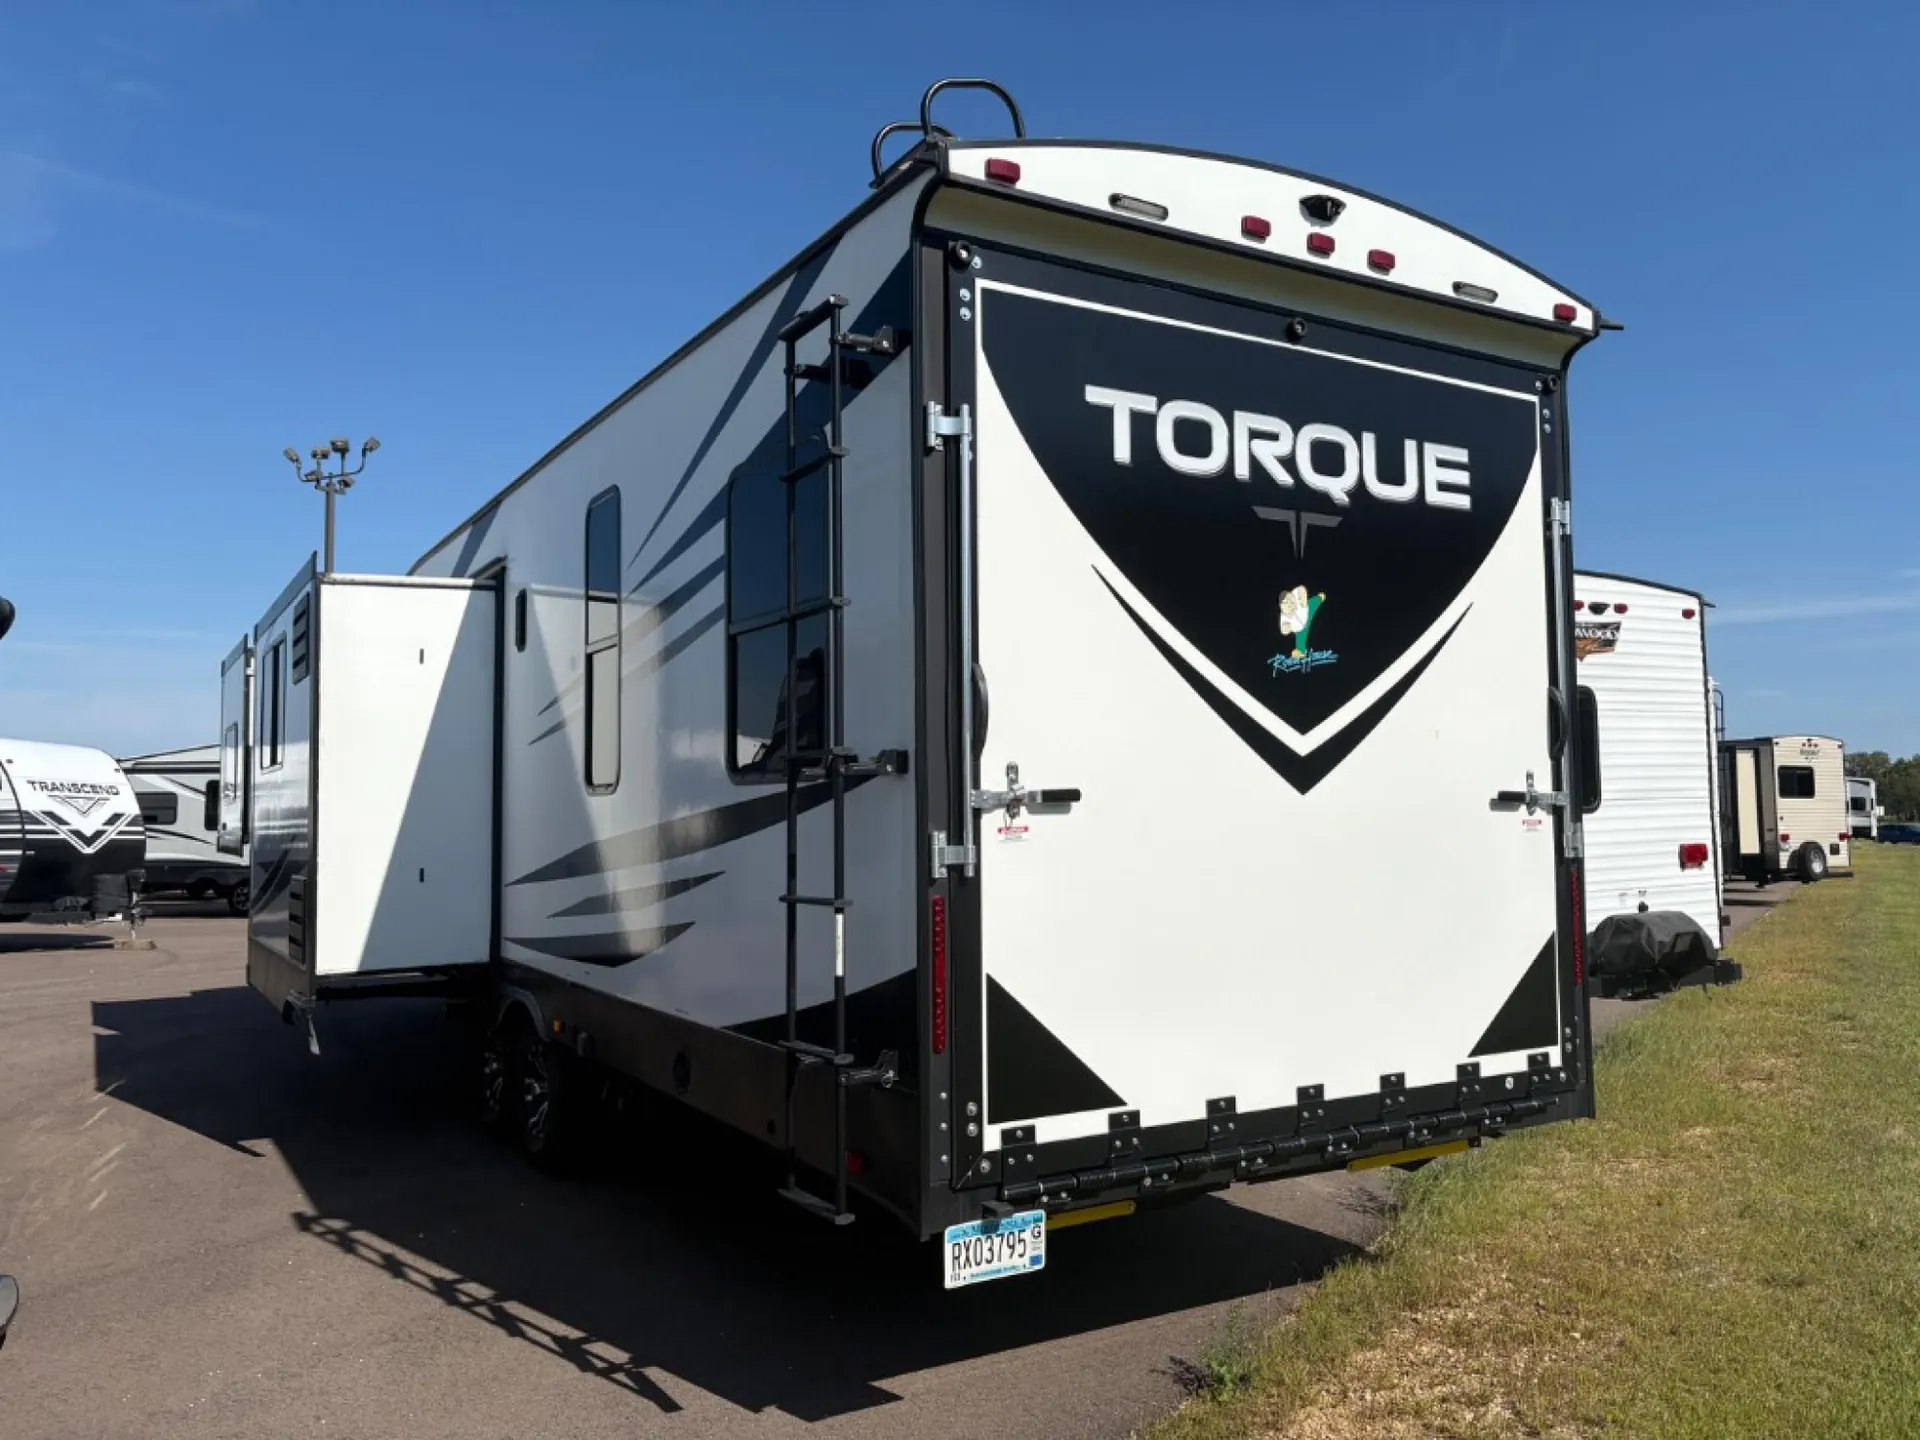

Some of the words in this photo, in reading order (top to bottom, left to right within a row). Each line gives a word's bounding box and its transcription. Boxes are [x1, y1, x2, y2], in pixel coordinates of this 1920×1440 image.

[1084, 384, 1472, 511] TORQUE
[26, 779, 120, 796] TRANSCEND
[951, 1230, 1027, 1273] RX03795
